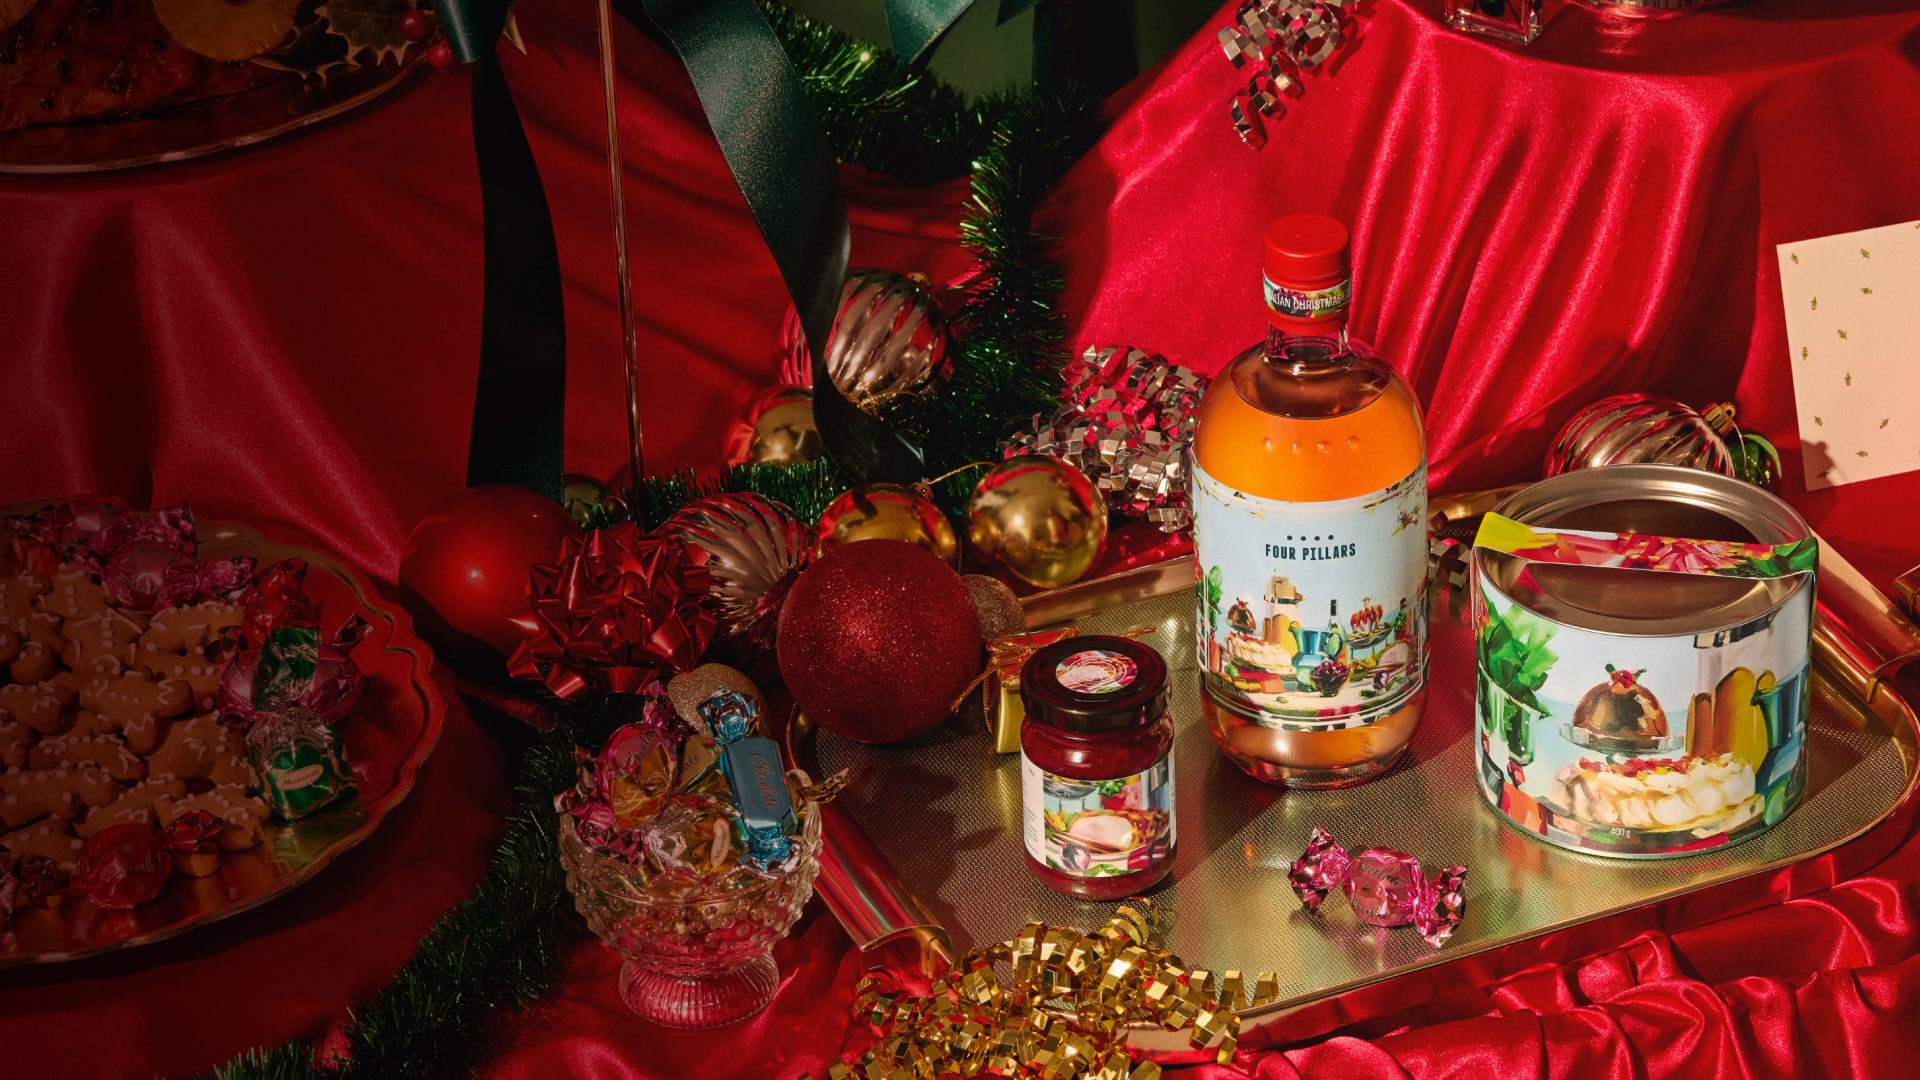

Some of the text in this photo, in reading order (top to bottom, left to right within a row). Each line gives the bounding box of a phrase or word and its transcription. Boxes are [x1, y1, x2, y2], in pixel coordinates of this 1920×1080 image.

[1293, 294, 1342, 310] CHRISTMAS
[1265, 543, 1356, 560] FOUR PILLARS
[1610, 827, 1625, 836] 400
